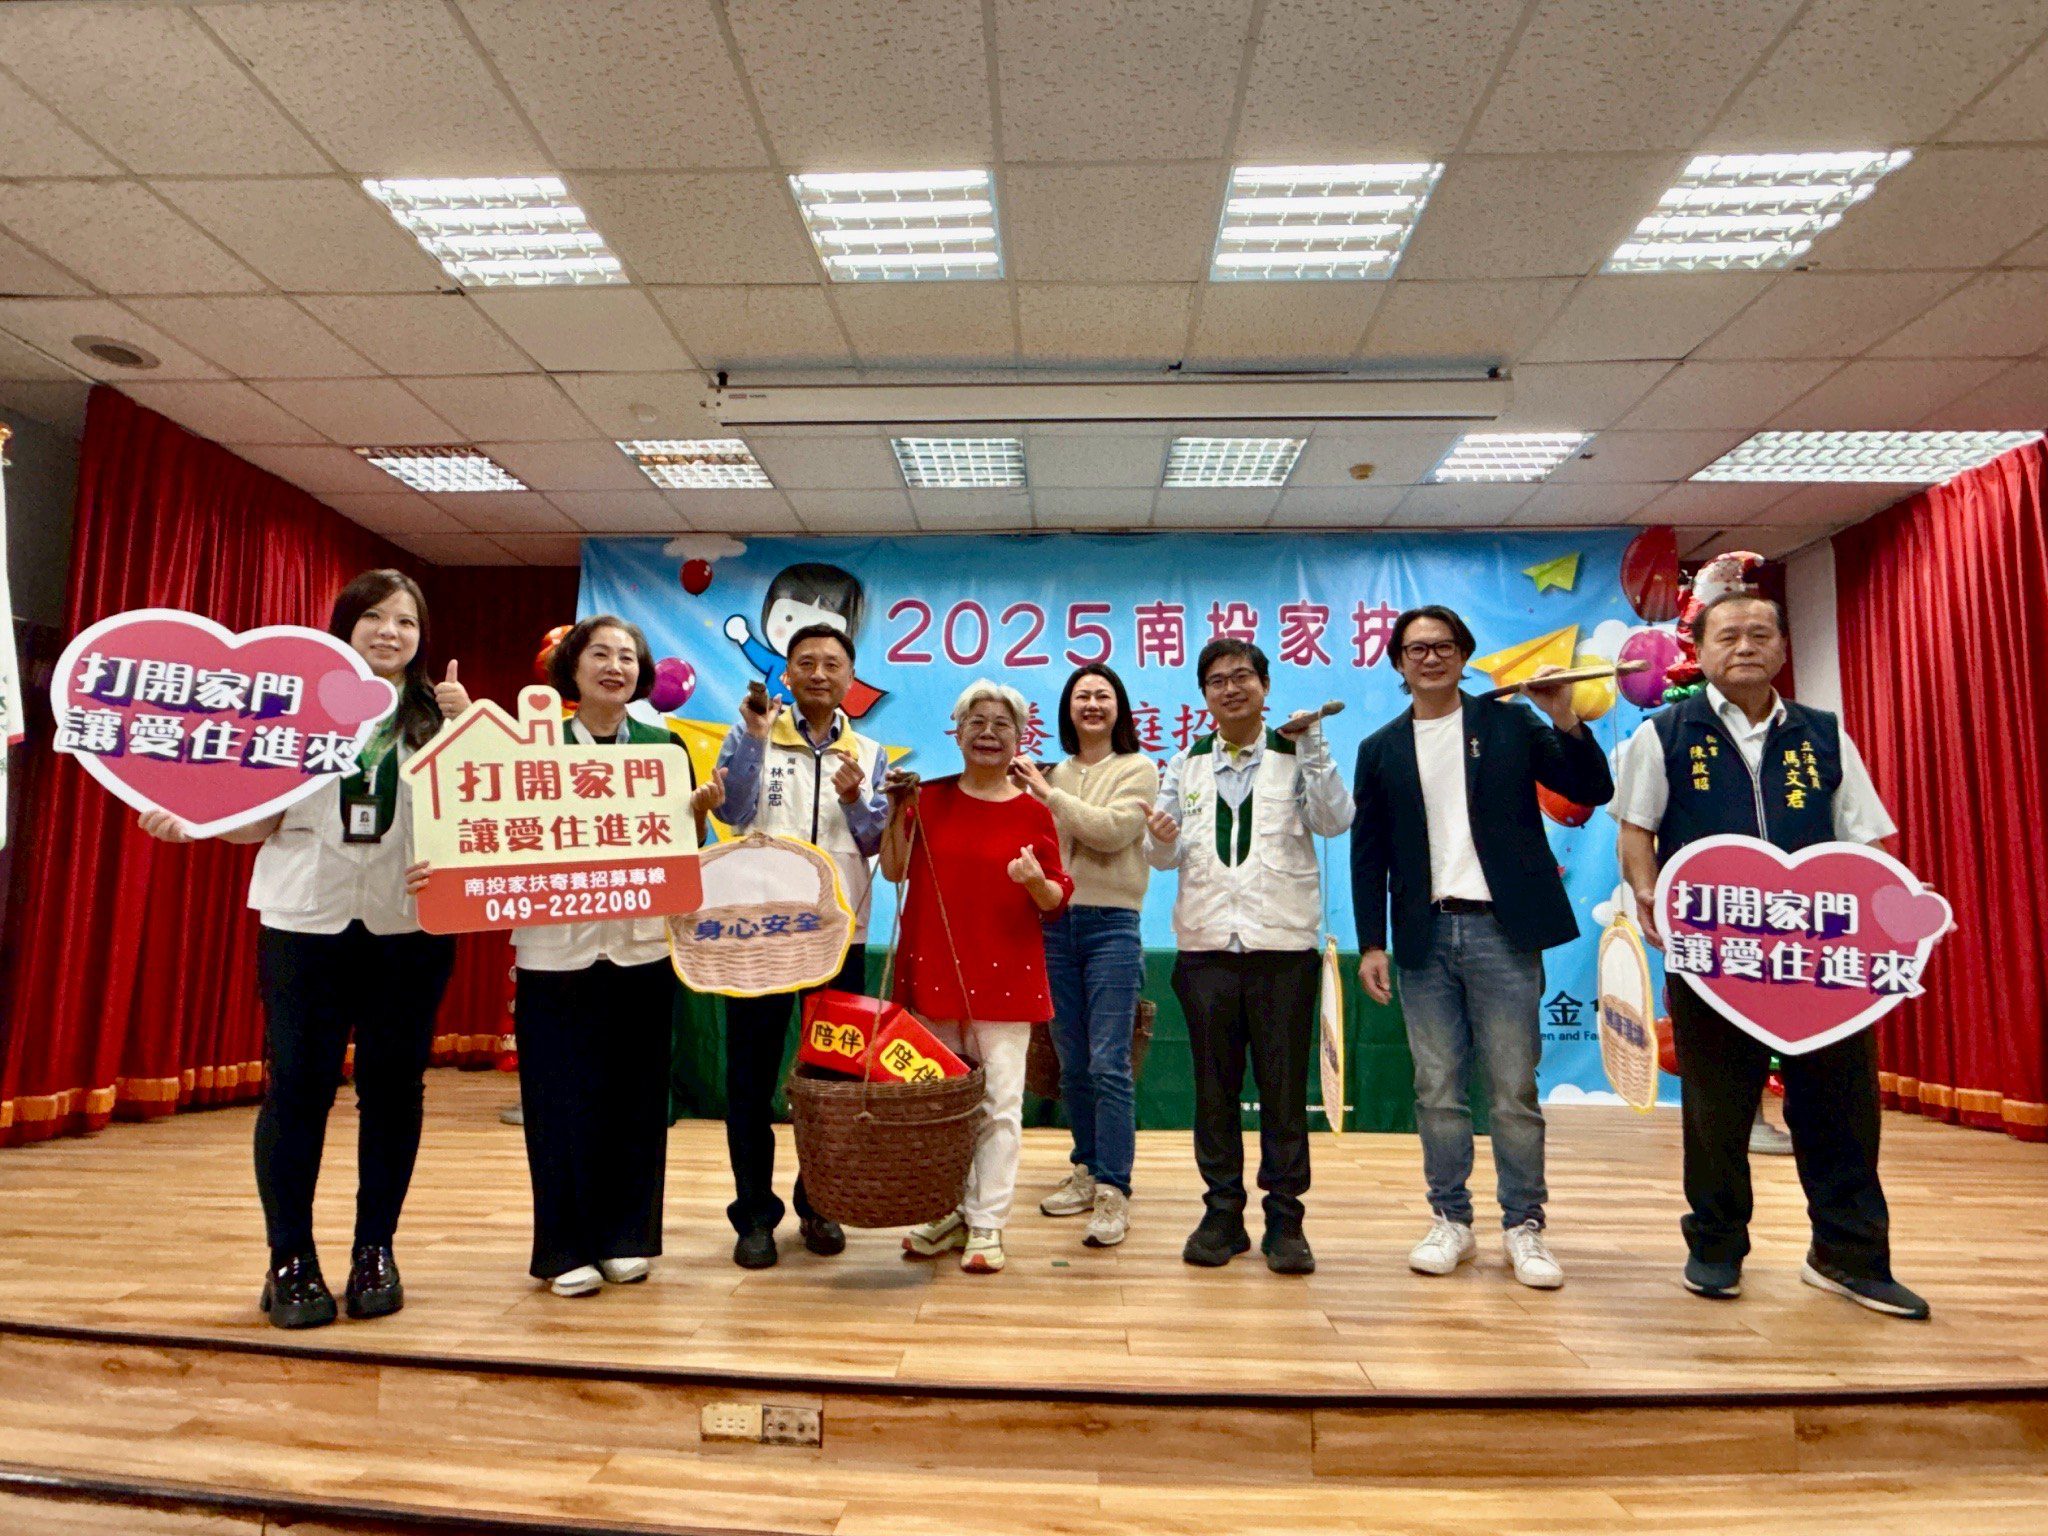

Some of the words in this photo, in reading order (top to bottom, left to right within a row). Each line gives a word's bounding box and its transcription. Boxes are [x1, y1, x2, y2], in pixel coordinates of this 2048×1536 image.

[886, 599, 1400, 669] 2025南投家扶
[74, 651, 305, 716] 打開家門
[57, 705, 359, 773] 讓愛住進來
[457, 758, 667, 803] 打開家門
[768, 766, 784, 807] 林志忠
[1782, 750, 1807, 809] 馬文君
[1801, 740, 1821, 790] 立法委員
[458, 812, 673, 854] 讓愛住進來
[464, 866, 667, 897] 南投家扶寄養招募專線
[485, 888, 652, 921] 049-2222080
[1671, 880, 1859, 935] 打開家門
[694, 912, 822, 942] 身心安全
[1667, 931, 1920, 994] 讓愛住進來
[814, 1024, 861, 1055] 陪伴
[1559, 1031, 1580, 1041] and
[1584, 1031, 1599, 1041] Fa
[885, 1042, 939, 1081] 陪伴
